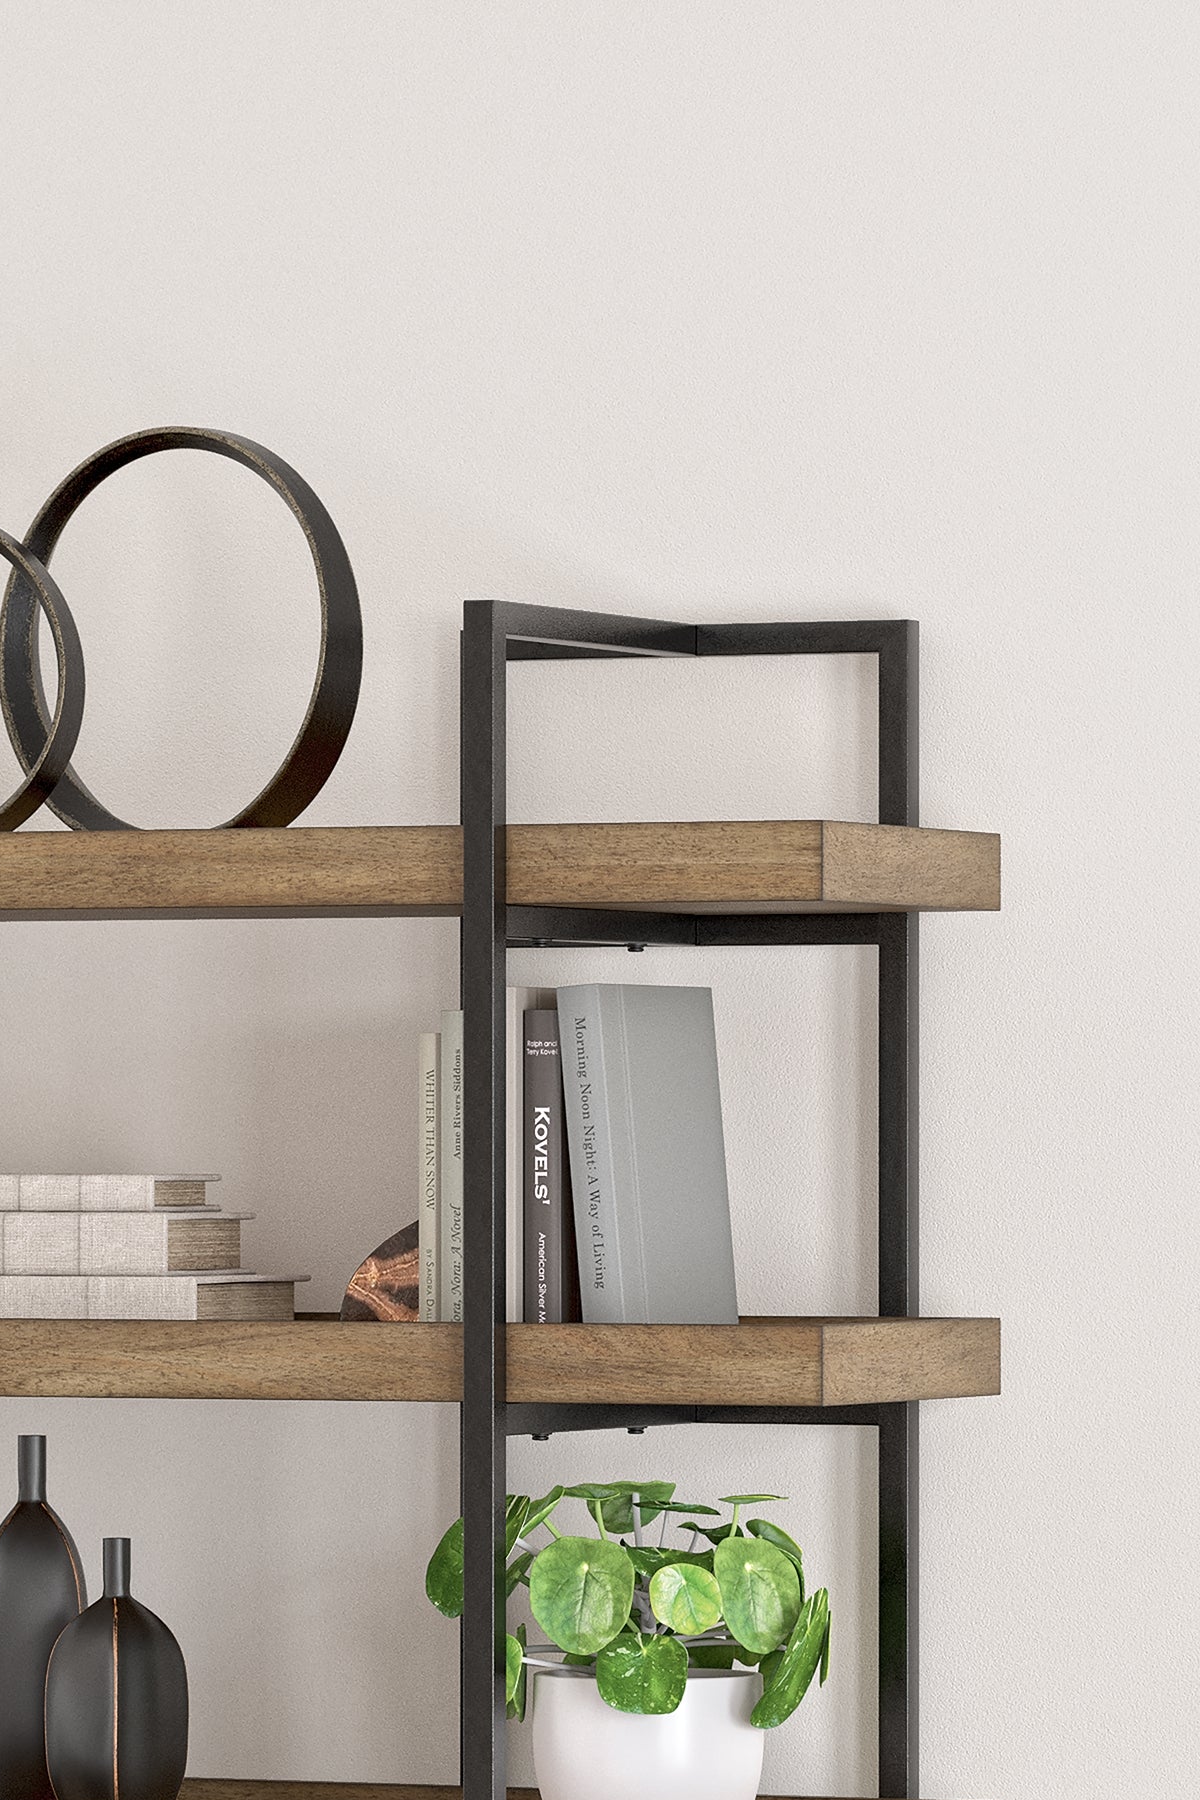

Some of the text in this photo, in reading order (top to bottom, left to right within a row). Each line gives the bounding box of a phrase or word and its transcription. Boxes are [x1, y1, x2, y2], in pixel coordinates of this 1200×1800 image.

[543, 1040, 558, 1048] and
[452, 1048, 462, 1160] Anne Rivers Siddons
[425, 1069, 435, 1210] WHITER THAN SNOW
[574, 1017, 606, 1290] Morning Noon Night: A Way of Living
[449, 1203, 462, 1243] Novel
[451, 1246, 463, 1258] A
[538, 1231, 547, 1281] American
[450, 1260, 462, 1296] Nora:
[538, 1282, 547, 1310] Silver
